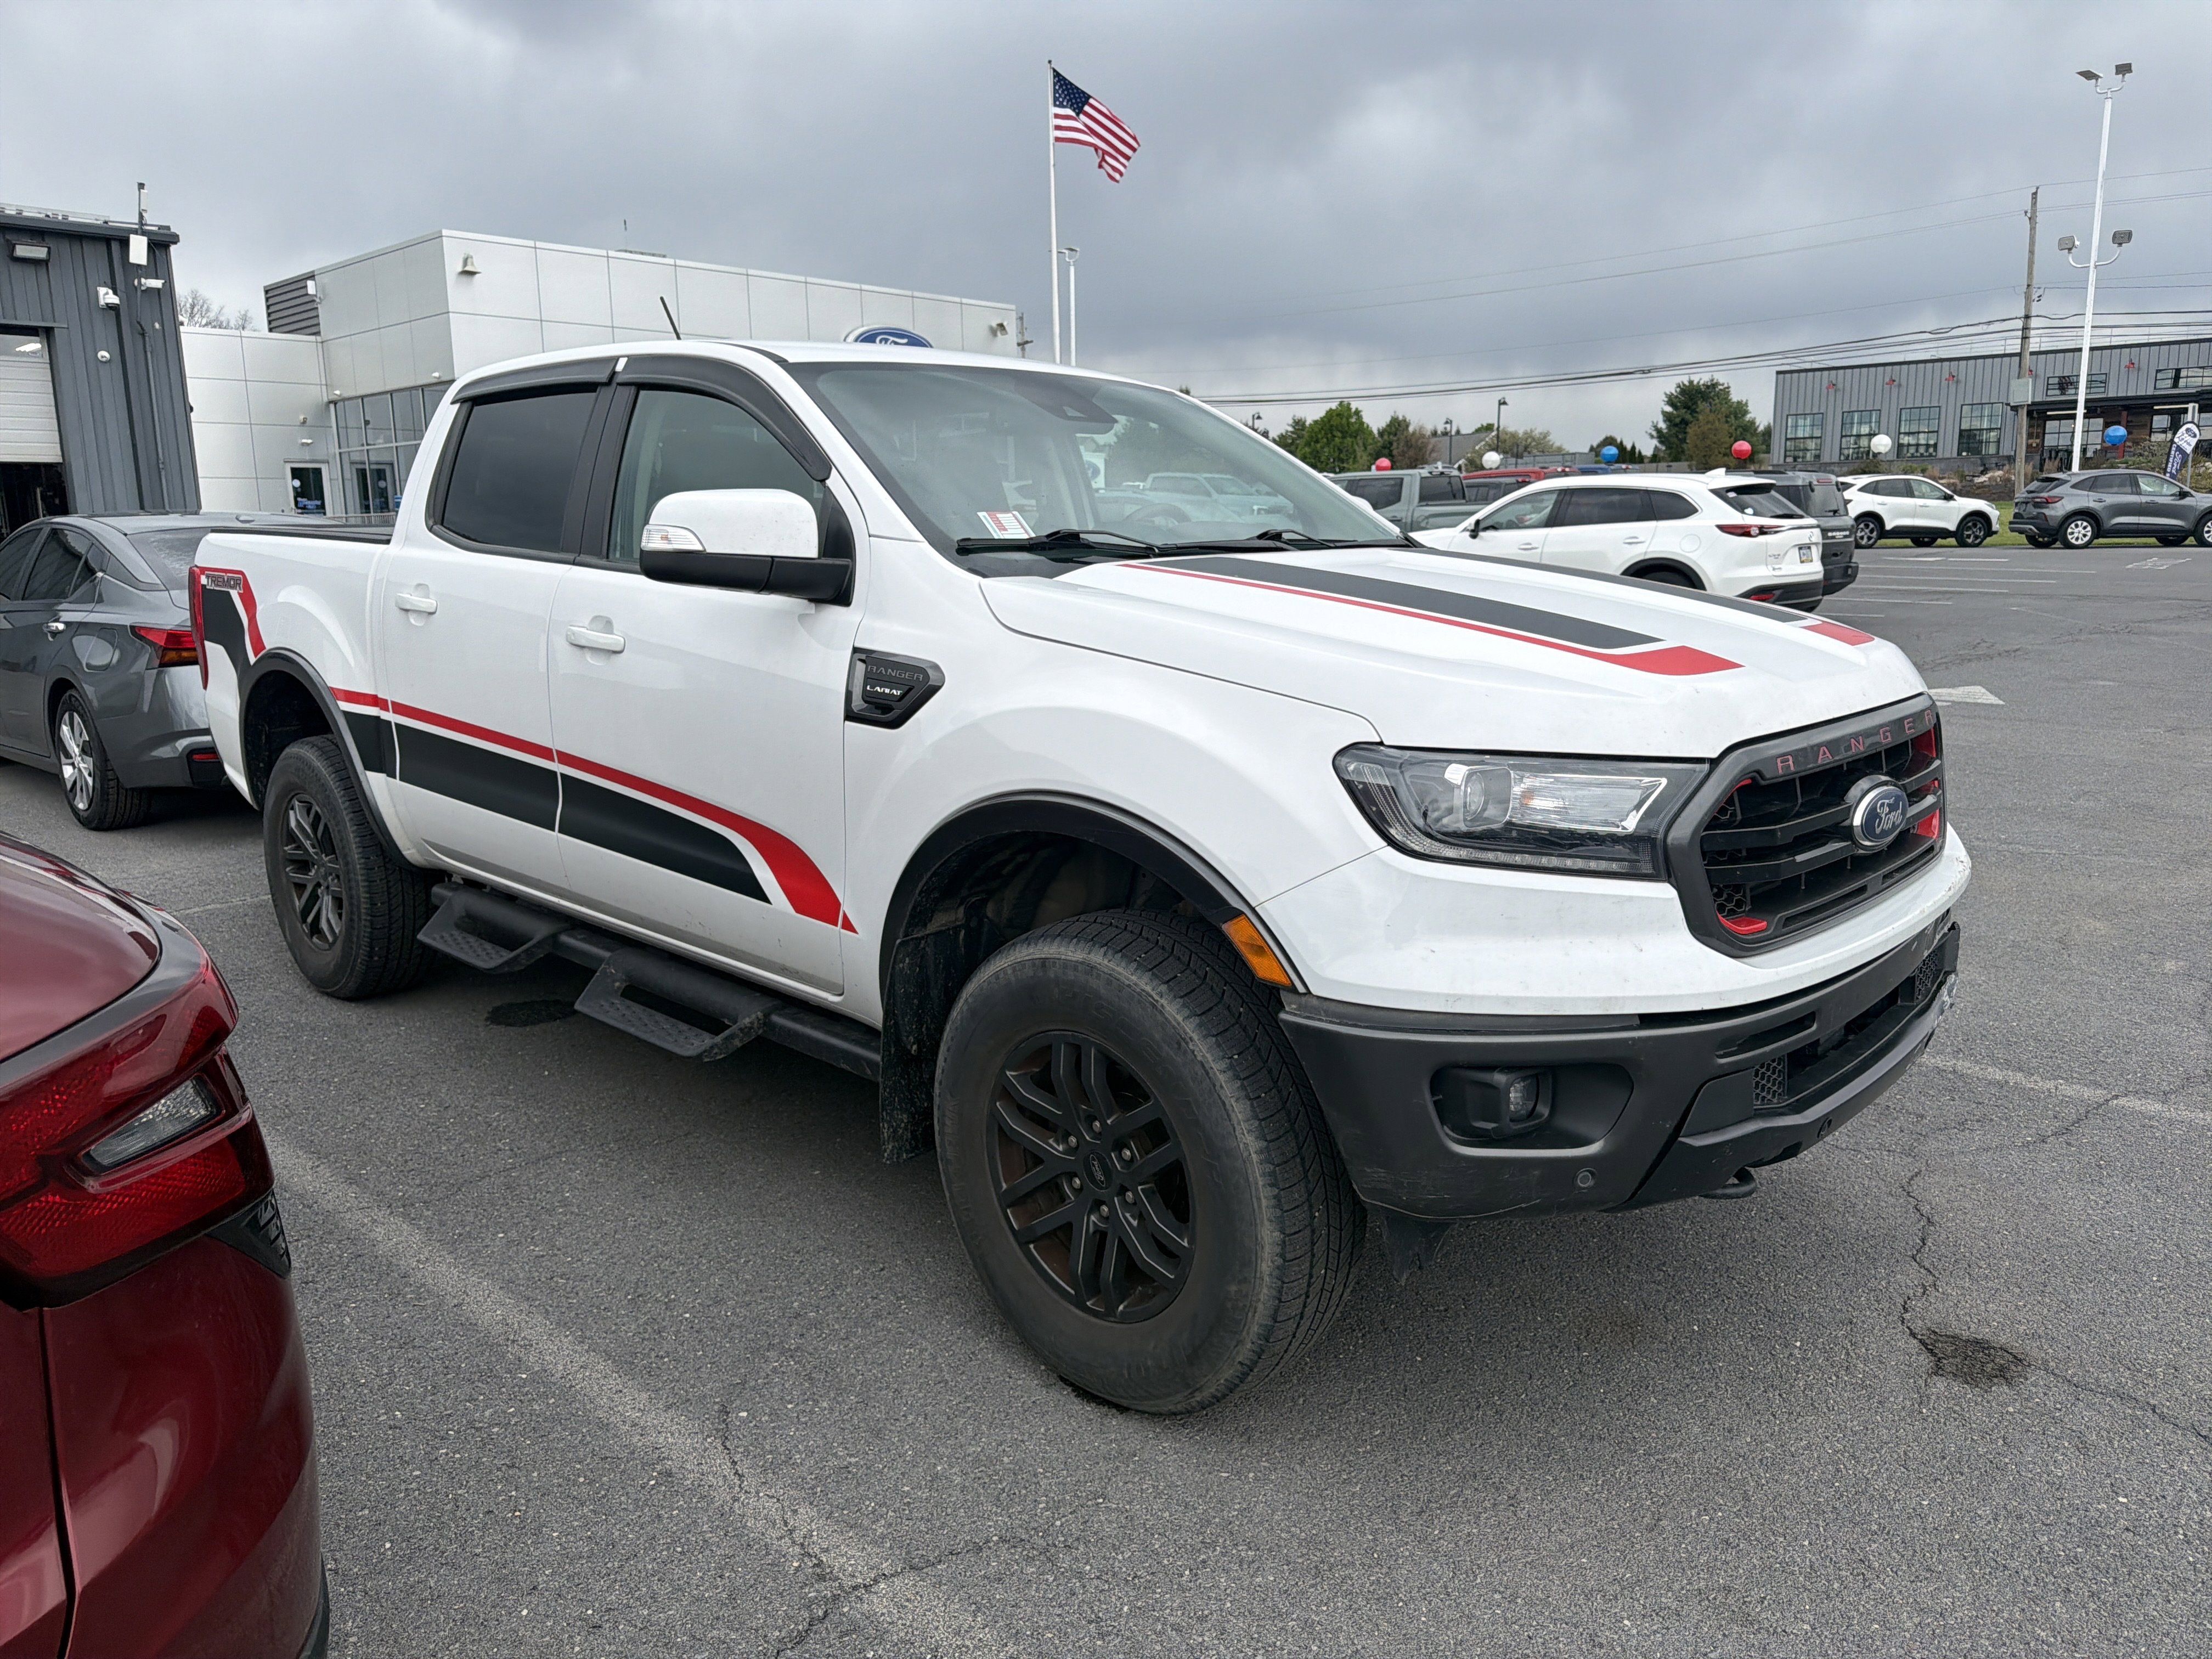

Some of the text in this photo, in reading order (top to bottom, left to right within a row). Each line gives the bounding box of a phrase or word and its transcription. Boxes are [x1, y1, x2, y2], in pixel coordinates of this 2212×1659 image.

[2172, 451, 2182, 475] Ford
[205, 573, 242, 591] TREMOR
[867, 665, 923, 681] RANGER
[866, 685, 903, 696] LARIAT
[1776, 709, 1933, 775] RANGER
[1875, 797, 1903, 834] Ford
